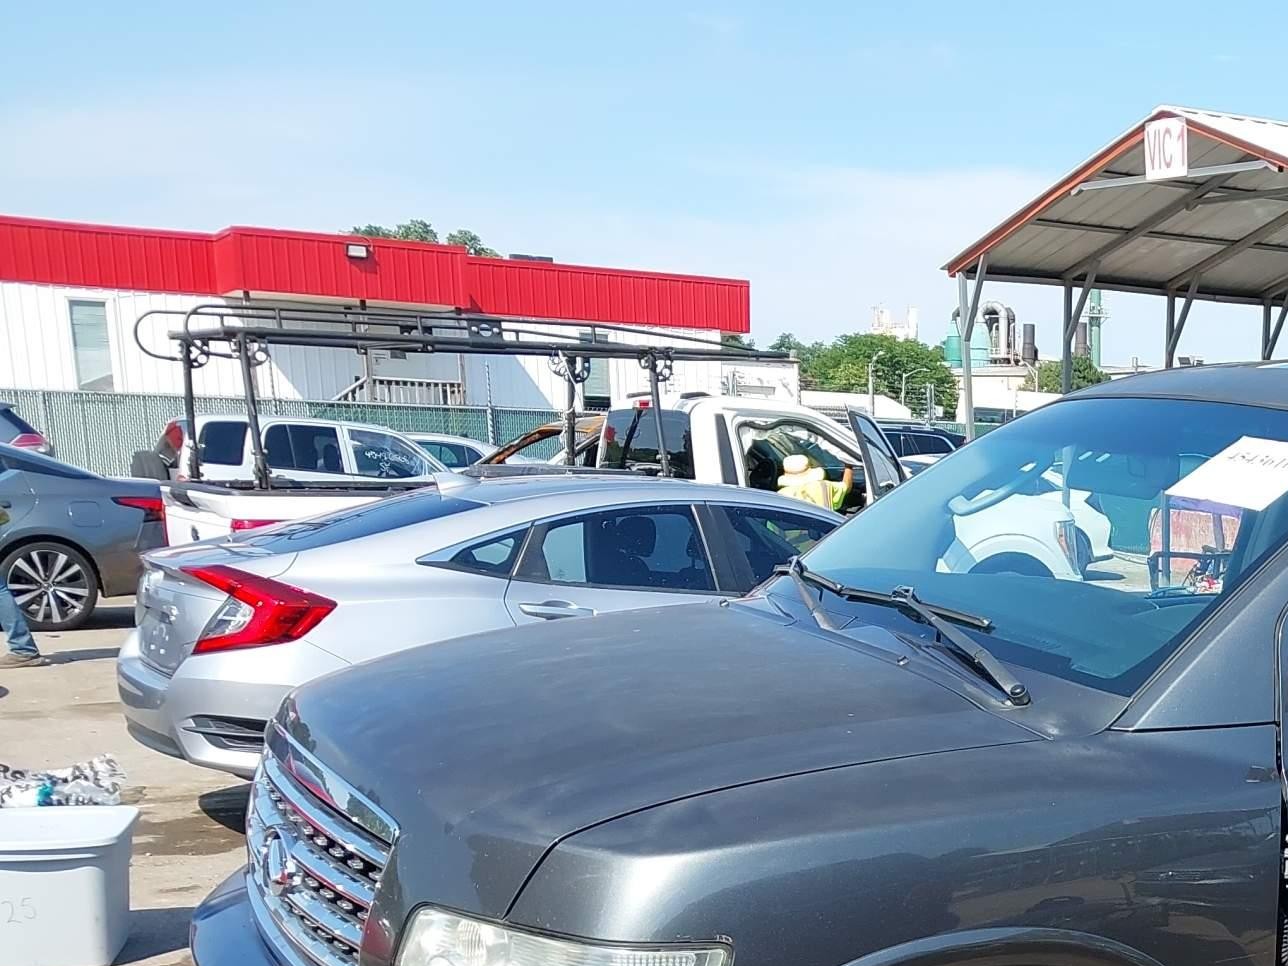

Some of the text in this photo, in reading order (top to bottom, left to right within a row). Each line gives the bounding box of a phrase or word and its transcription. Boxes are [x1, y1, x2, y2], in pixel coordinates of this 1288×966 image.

[1146, 125, 1186, 170] VIC 1
[1, 897, 37, 924] 25
